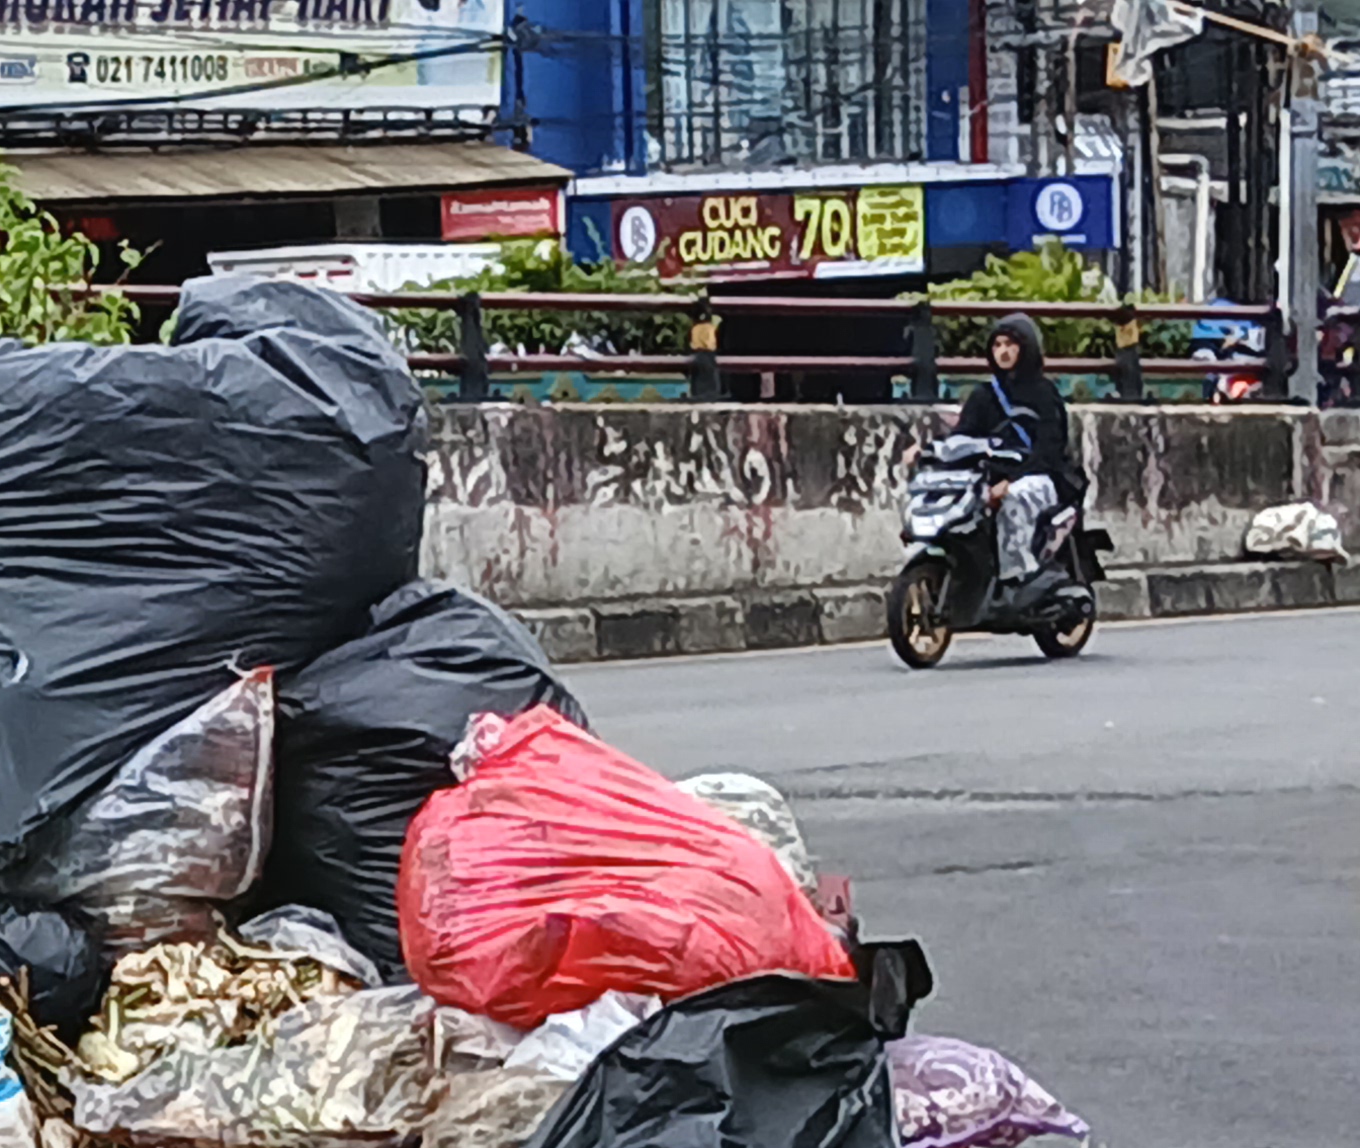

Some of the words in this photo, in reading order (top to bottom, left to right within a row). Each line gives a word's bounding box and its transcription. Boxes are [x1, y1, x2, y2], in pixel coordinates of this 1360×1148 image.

[95, 57, 133, 83] 021
[144, 55, 229, 82] 7411008
[702, 196, 758, 228] CUCI
[793, 197, 851, 260] 70
[679, 227, 781, 262] GUDANG
